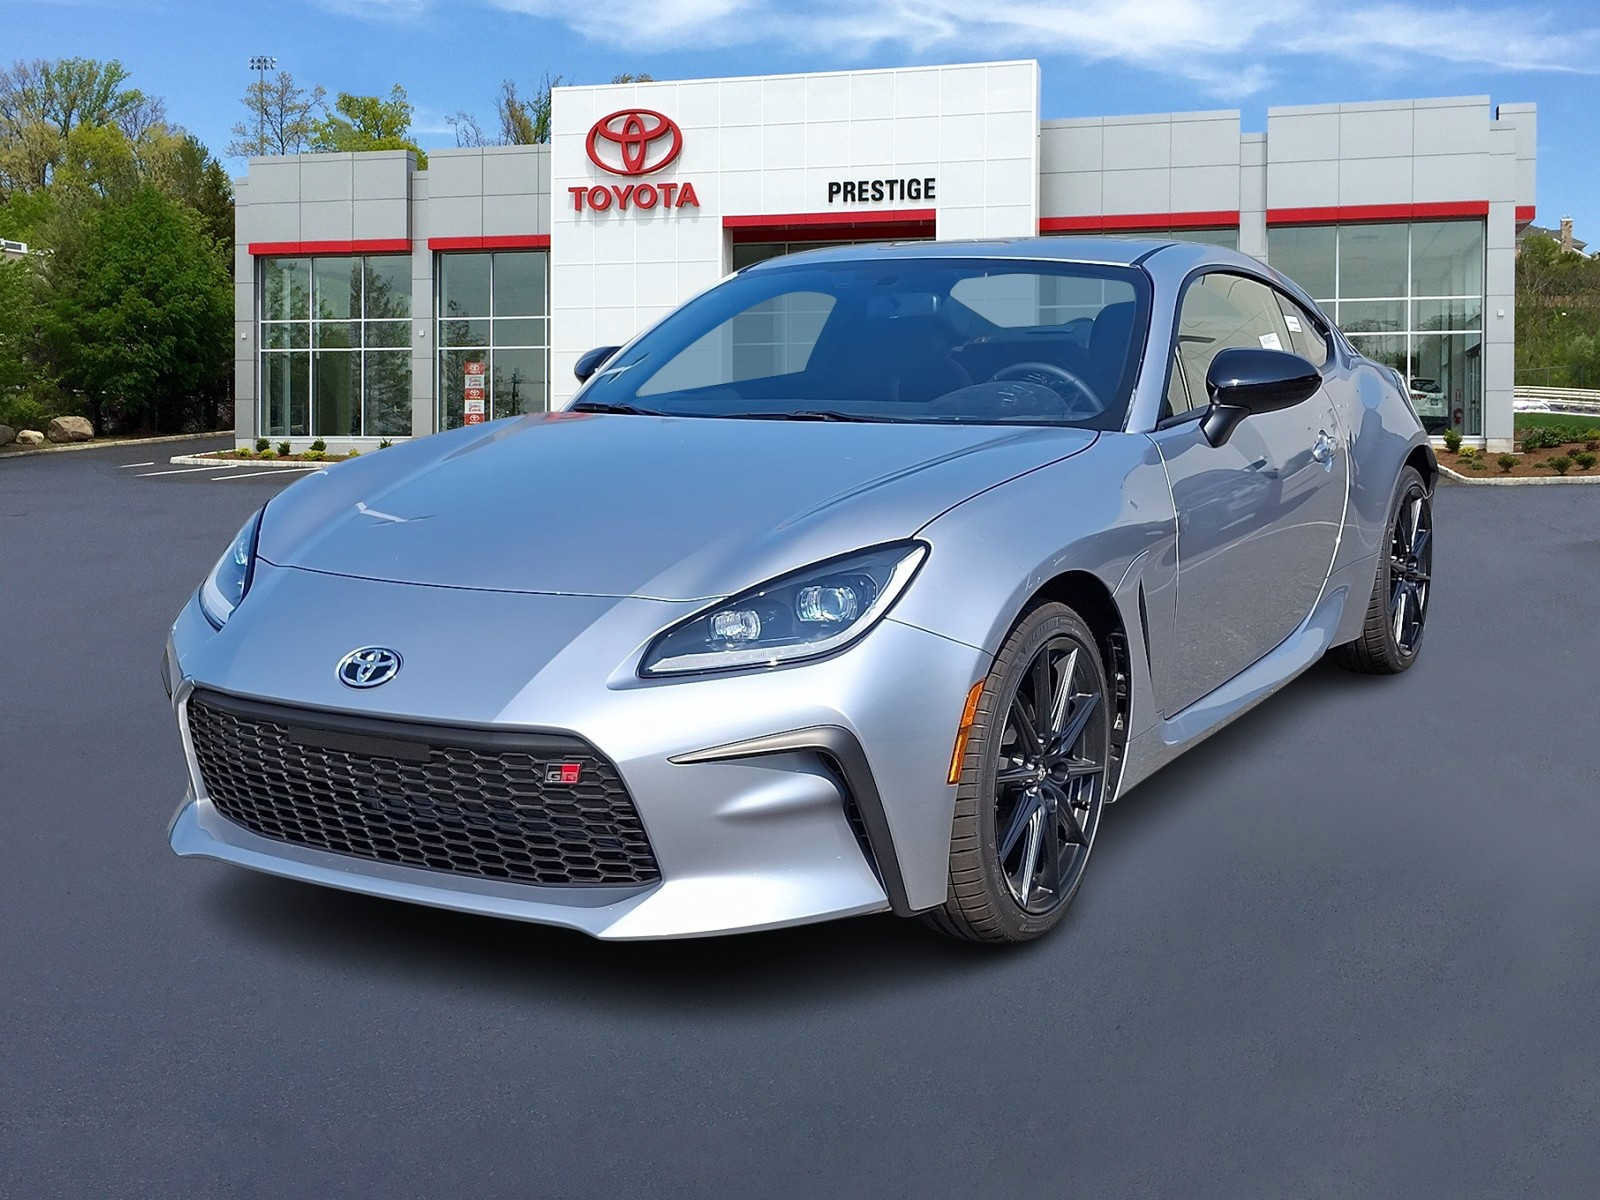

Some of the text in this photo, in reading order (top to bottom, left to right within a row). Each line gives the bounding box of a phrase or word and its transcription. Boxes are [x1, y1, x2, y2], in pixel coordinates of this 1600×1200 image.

[568, 182, 700, 212] TOYOTA
[828, 178, 936, 203] PRESTIGE
[546, 767, 579, 782] GR
